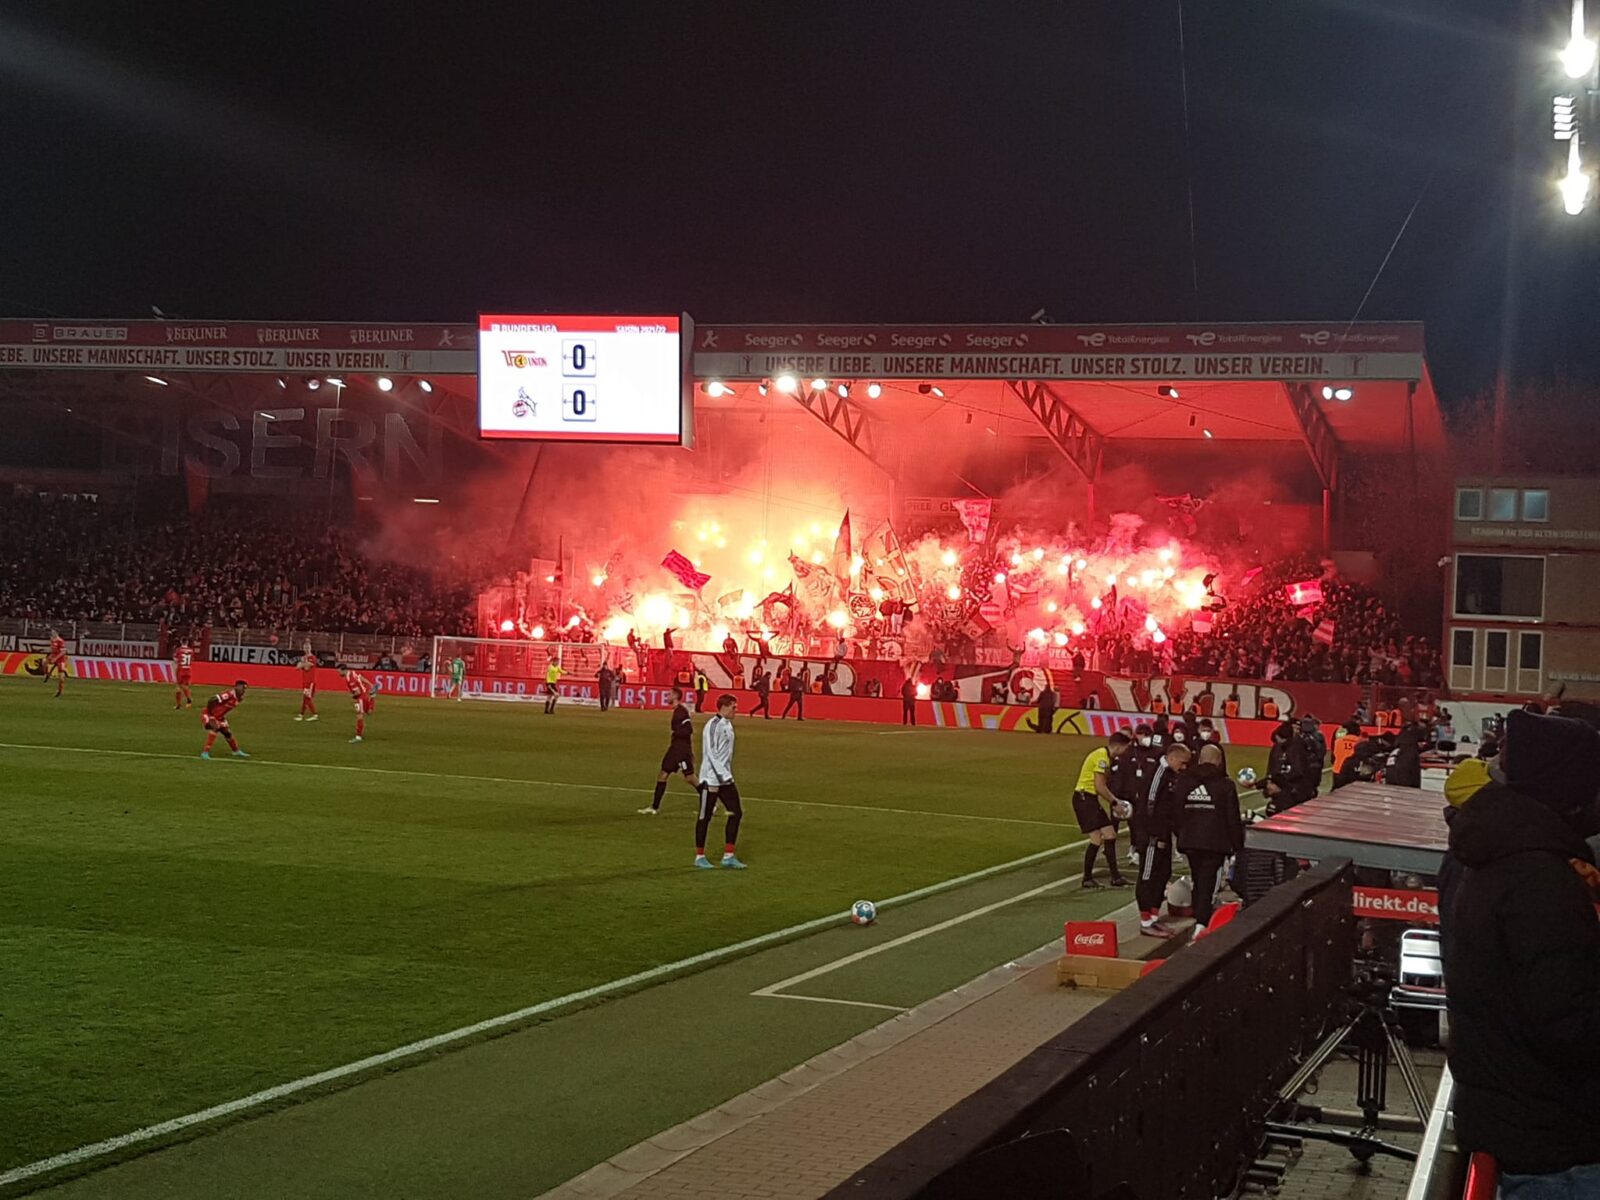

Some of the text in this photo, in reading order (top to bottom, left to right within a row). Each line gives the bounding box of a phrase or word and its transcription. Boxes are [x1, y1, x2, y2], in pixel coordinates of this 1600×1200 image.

[54, 329, 127, 339] BRAUER
[174, 326, 227, 341] BERLINER
[265, 327, 319, 342] BERLINER
[358, 328, 413, 343] BERLINER
[745, 333, 789, 347] Seeger
[817, 333, 862, 347] Seeger
[891, 333, 937, 348] Seeger
[966, 333, 1013, 348] Seeger
[33, 349, 83, 364] UNSERE
[87, 350, 181, 366] MANNSCHAFT.
[186, 351, 230, 367] UNSER
[233, 351, 278, 368] STOLZ.
[286, 352, 331, 368] UNSER
[335, 352, 389, 369] VEREIN.
[573, 345, 586, 370] 0
[765, 356, 1329, 375] UNSERE LIEBE. UNSERE MANNSCHAFT. UNSER STOLZ. UNSER VEREIN.
[573, 390, 586, 415] 0
[181, 652, 191, 666] 31
[74, 659, 174, 683] UNION
[536, 683, 592, 699] ATEN
